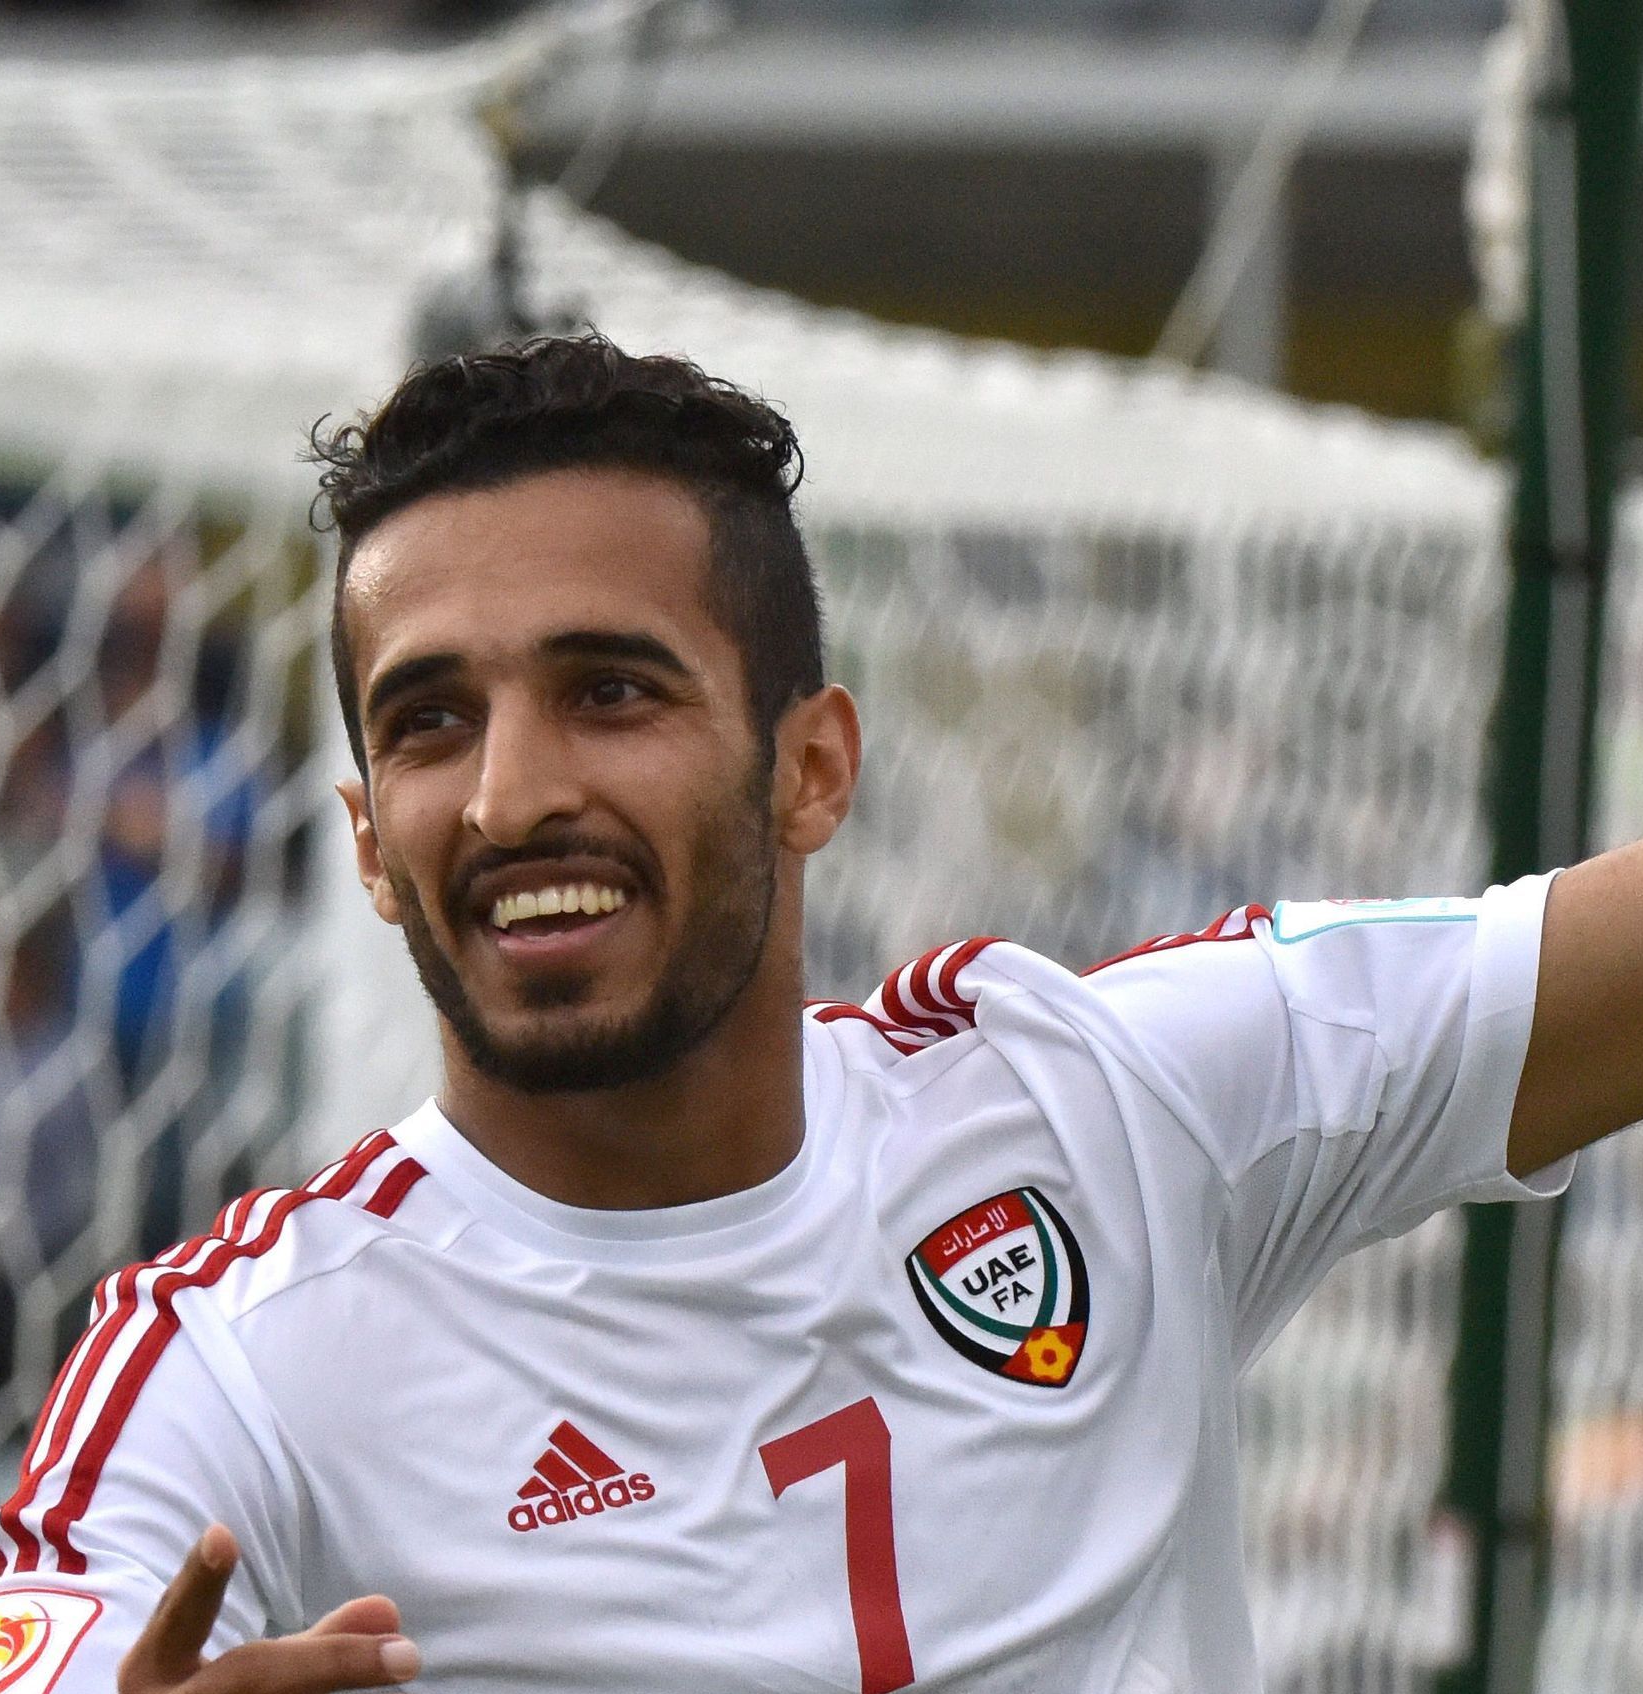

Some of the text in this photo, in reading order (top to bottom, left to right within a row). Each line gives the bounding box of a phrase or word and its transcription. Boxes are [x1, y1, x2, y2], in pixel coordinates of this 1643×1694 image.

[961, 1243, 1037, 1296] UAE
[991, 1280, 1035, 1313] FA
[507, 1472, 656, 1533] adidas
